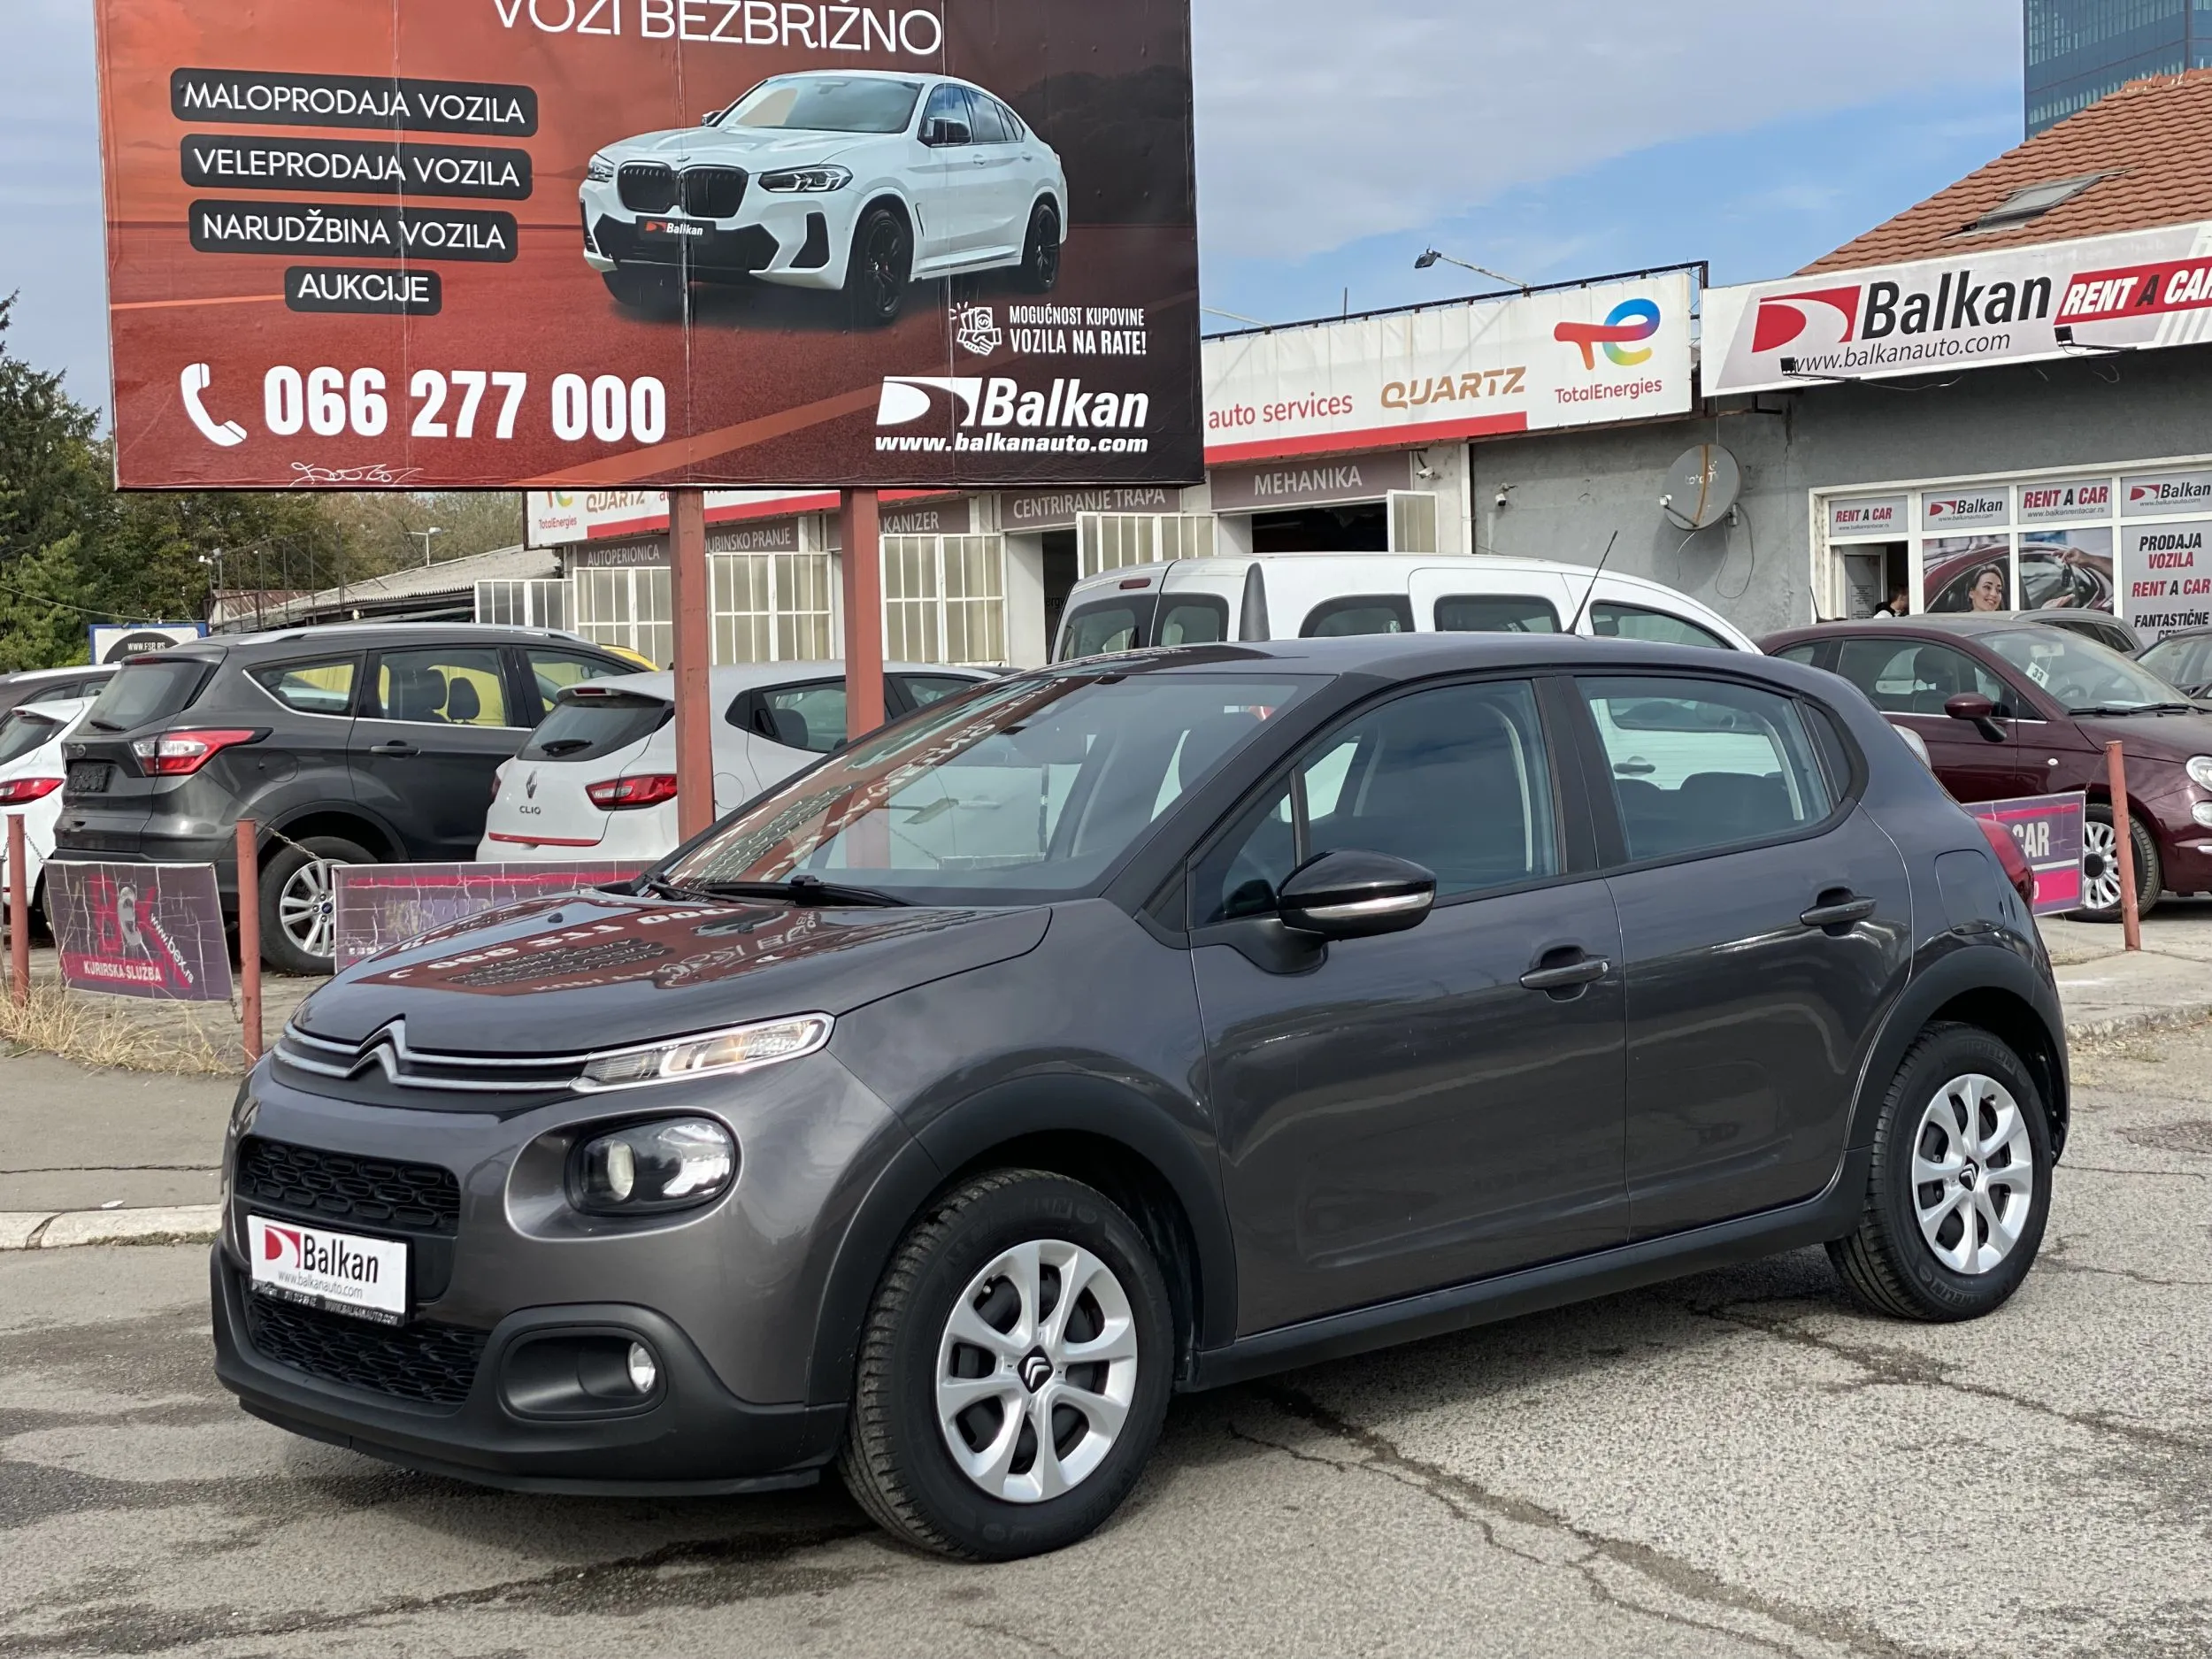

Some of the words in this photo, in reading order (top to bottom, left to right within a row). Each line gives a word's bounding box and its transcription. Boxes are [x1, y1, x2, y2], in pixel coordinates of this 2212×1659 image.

[494, 0, 621, 35] VOZI
[641, 0, 942, 55] BEZBRIŽNO
[183, 81, 411, 117] MALOPRODAJA
[418, 93, 526, 124] VOZILA
[194, 148, 406, 181] VELEPRODAJA
[413, 157, 520, 188] VOZILA
[203, 209, 391, 245] NARUDŽBINA
[399, 219, 506, 250] VOZILA
[666, 222, 703, 235] Balkan
[296, 273, 430, 303] AUKCIJE
[2061, 276, 2139, 317] RENT
[2134, 274, 2160, 307] A
[1009, 303, 1082, 326] MOGUĆNOST
[1086, 307, 1145, 326] KUPOVINE
[1861, 270, 2052, 341] Balkan
[1010, 328, 1067, 353] VOZILA
[1072, 329, 1097, 354] NA
[1101, 330, 1147, 355] RATE!
[1380, 365, 1527, 410] QUARTZ
[1554, 377, 1663, 403] TotalEnergies
[264, 365, 388, 437] 066
[410, 369, 527, 440] 277
[550, 373, 665, 442] 000
[980, 377, 1149, 427] Balkan
[1208, 398, 1256, 429] auto
[1263, 391, 1354, 423] services
[875, 433, 1148, 452] www.balkanauto.com
[1255, 465, 1363, 495] MEHANIKA
[2161, 482, 2211, 499] Balkan
[1013, 489, 1111, 518] CENTRIRANJE
[1113, 488, 1165, 508] TRAPA
[1956, 498, 2003, 514] Balkan
[2023, 488, 2062, 509] RENT
[2062, 488, 2074, 506] A
[2078, 486, 2109, 505] CAR
[538, 516, 577, 530] TotalEnergies
[1835, 509, 1862, 523] RENT
[1862, 508, 1870, 521] A
[1872, 507, 1893, 520] CAR
[752, 527, 791, 548] PRANJE
[2139, 533, 2202, 551] PRODAJA
[588, 544, 660, 566] AUTOPERIONICA
[2148, 551, 2194, 569] VOZILA
[2131, 580, 2167, 597] RENT
[2169, 580, 2178, 595] A
[2183, 578, 2211, 595] CAR
[2134, 609, 2209, 628] FANTASTIČNE
[519, 805, 541, 814] CLIO
[83, 960, 124, 978] KURIRSKA
[126, 962, 163, 982] SLUŽBA
[303, 1233, 379, 1283] Balkan
[278, 1270, 364, 1300] www.balkanauto.com
